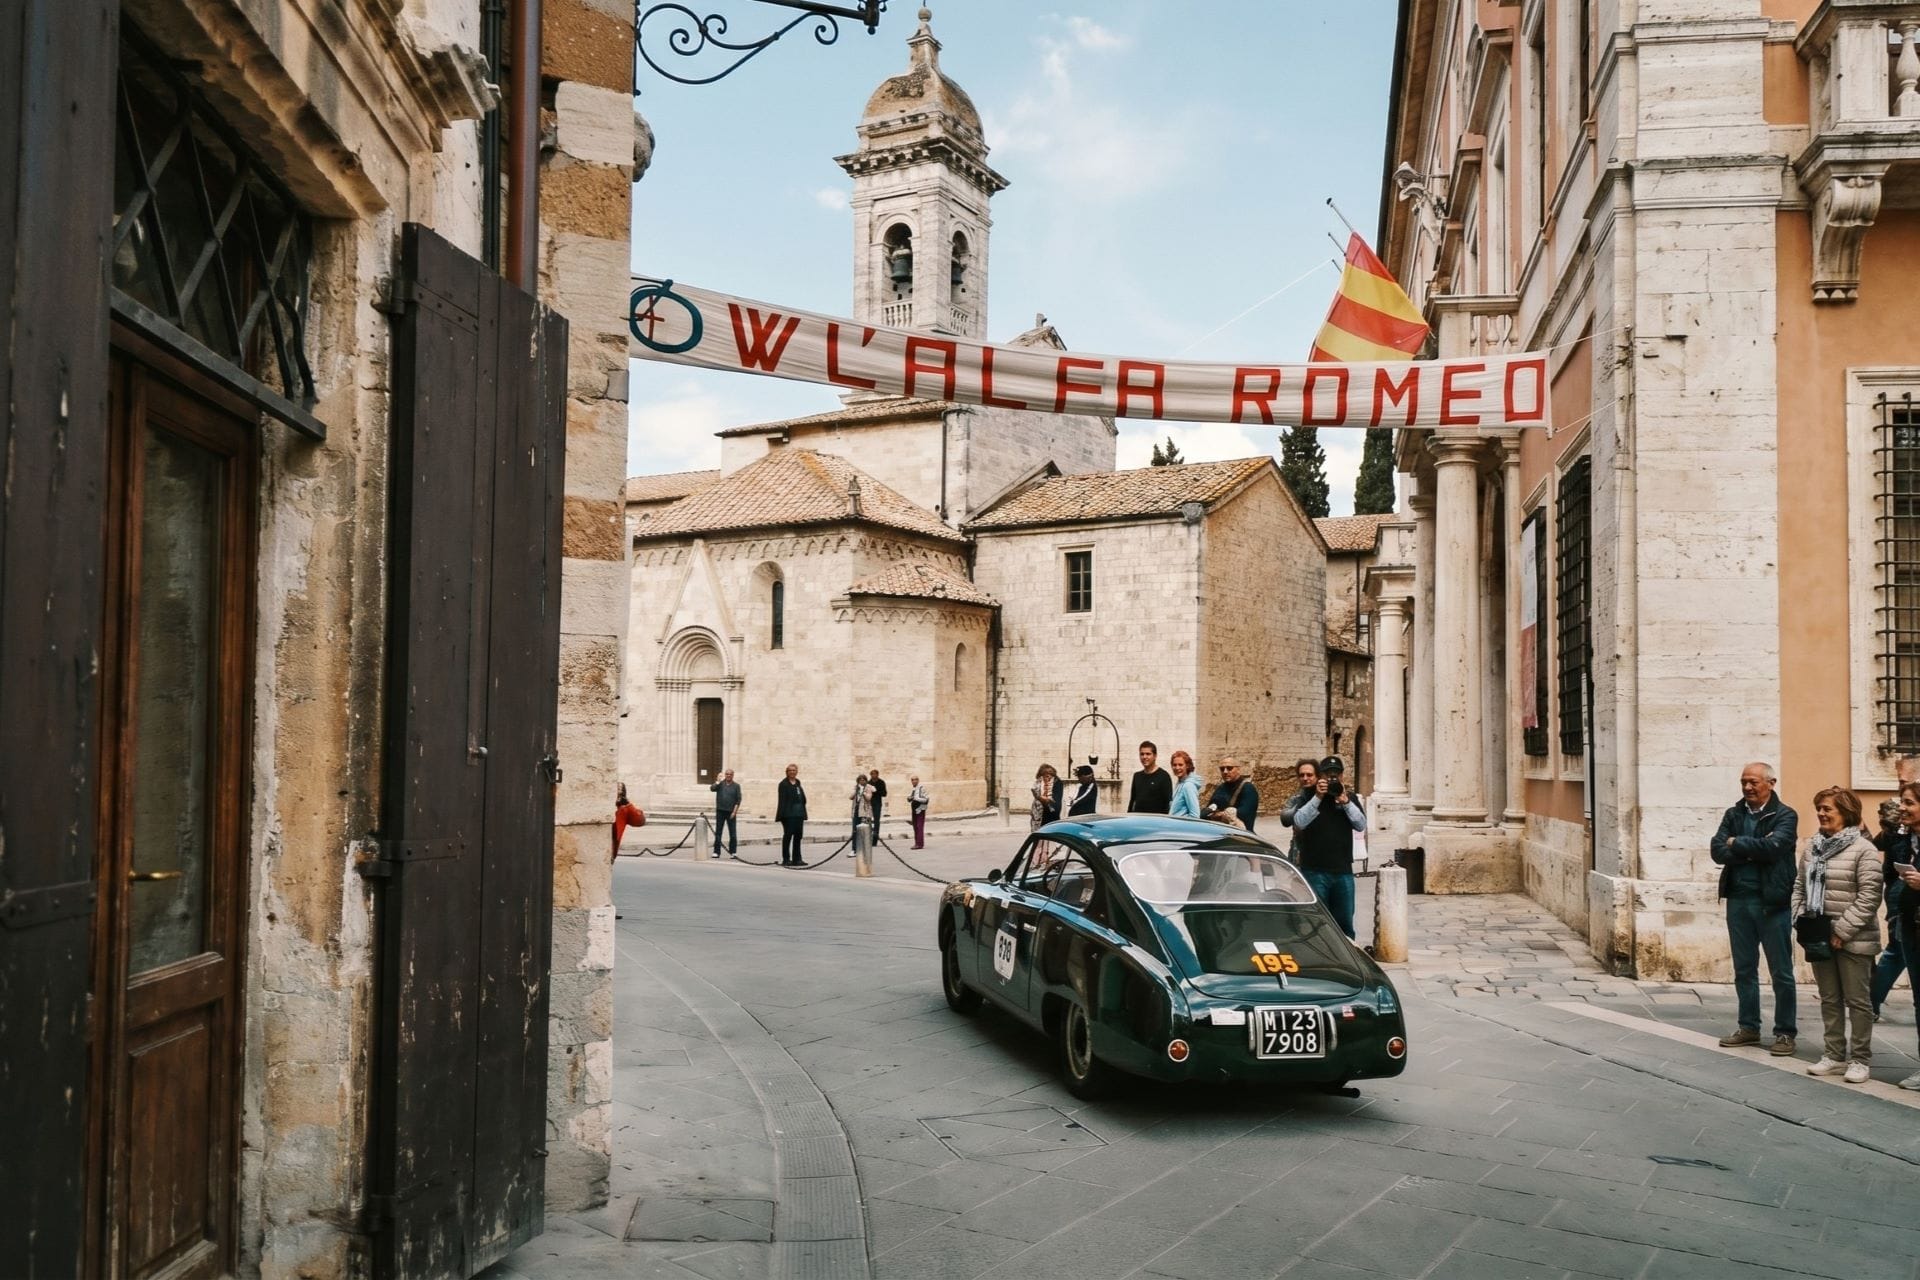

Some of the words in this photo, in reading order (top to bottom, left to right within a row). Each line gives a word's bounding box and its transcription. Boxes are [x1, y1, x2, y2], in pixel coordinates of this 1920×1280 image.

[728, 303, 800, 373] W
[827, 322, 1165, 418] L'ALFA
[1231, 358, 1546, 427] ROMEO
[1251, 954, 1300, 973] 195
[1263, 1010, 1287, 1030] MI
[1292, 1010, 1317, 1030] 23
[1264, 1032, 1318, 1053] 7908
